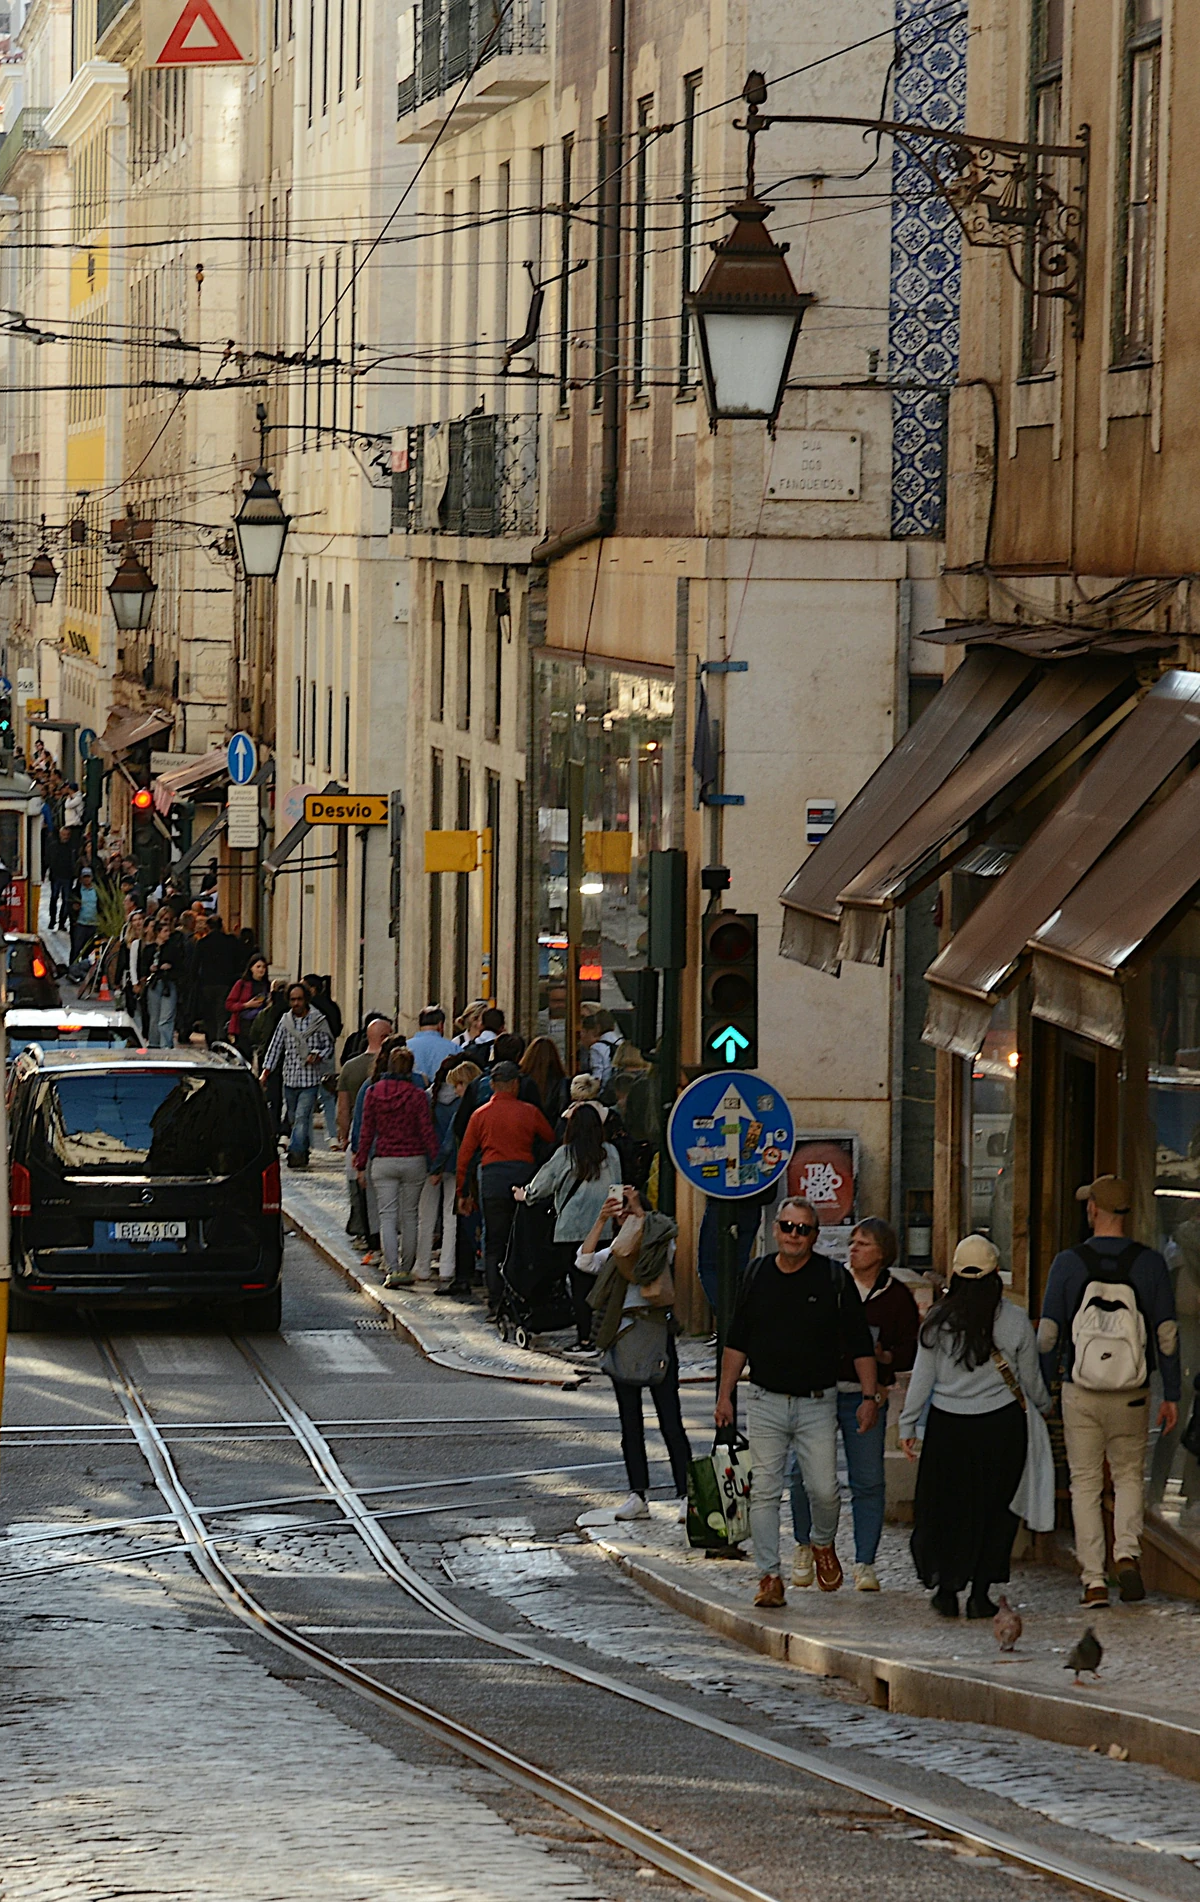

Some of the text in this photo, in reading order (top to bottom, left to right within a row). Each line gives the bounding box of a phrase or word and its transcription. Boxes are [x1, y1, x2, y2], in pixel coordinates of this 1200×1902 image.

[802, 440, 822, 451] RUA
[801, 459, 822, 471] DOS
[311, 802, 373, 818] Desvio
[804, 1162, 836, 1179] TRA
